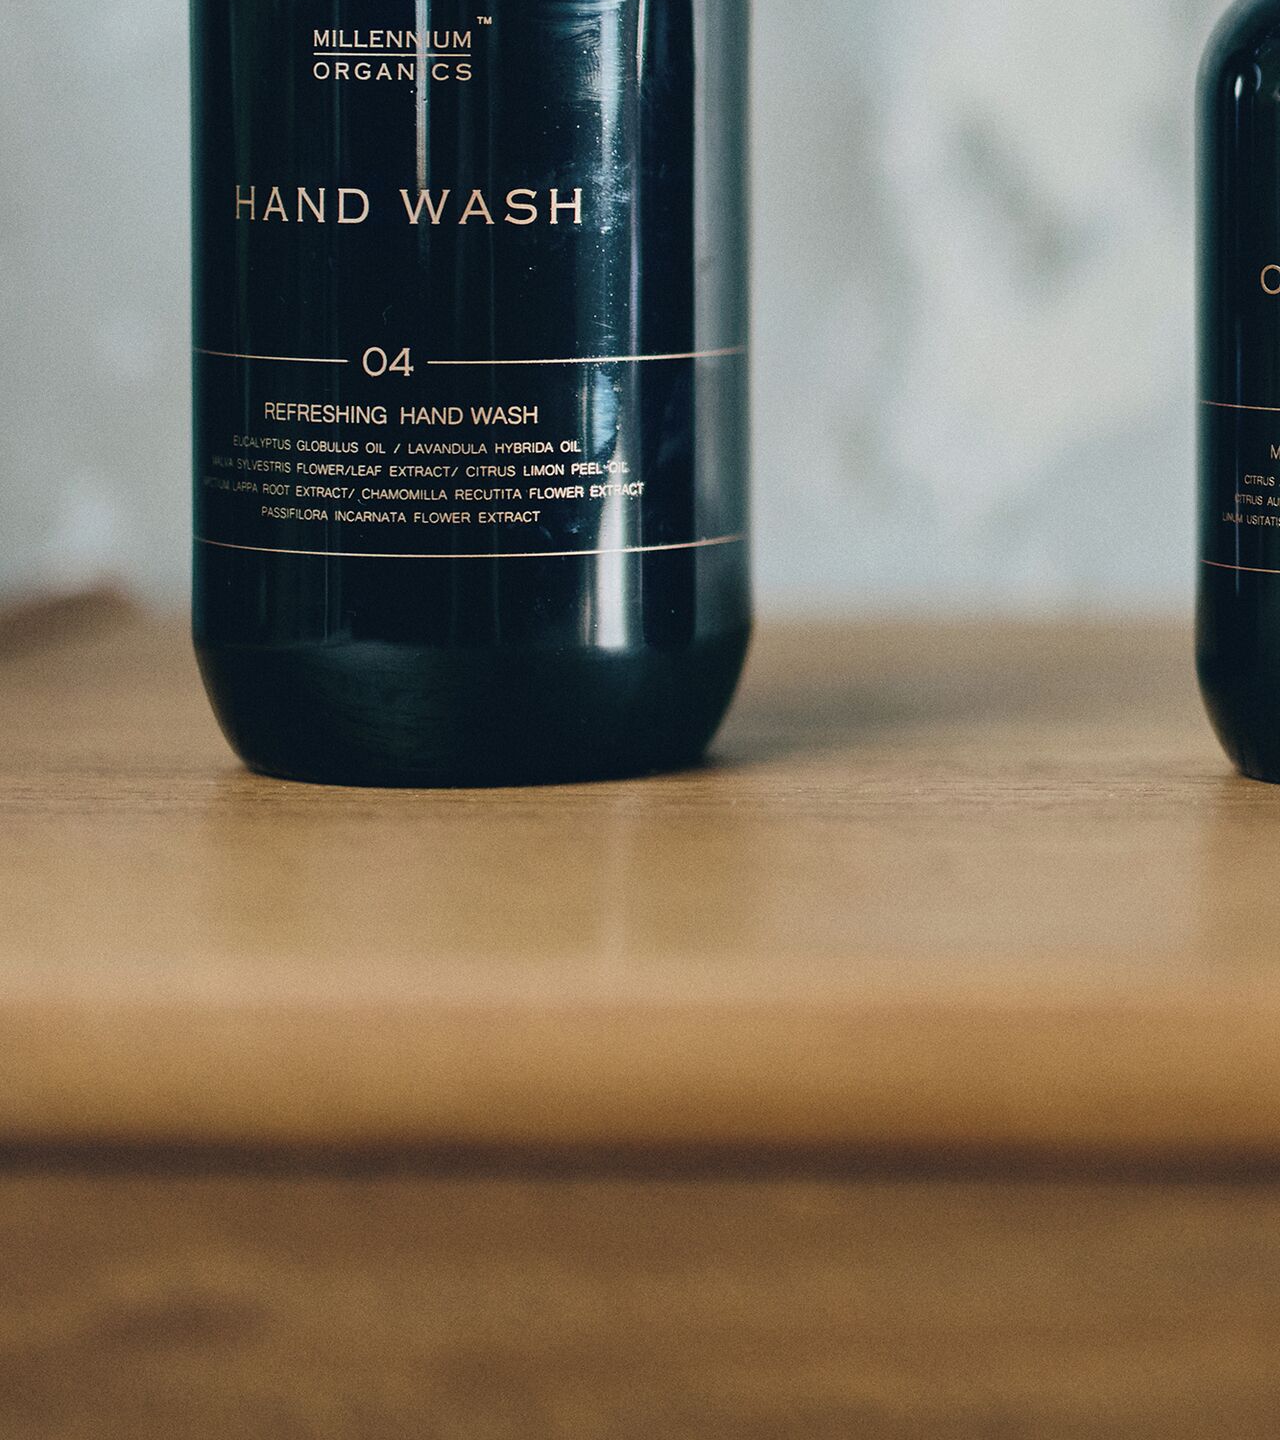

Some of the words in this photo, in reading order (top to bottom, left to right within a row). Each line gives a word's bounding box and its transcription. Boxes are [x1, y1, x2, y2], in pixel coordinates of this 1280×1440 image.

[313, 29, 472, 49] MILLENNIUM
[313, 62, 472, 81] ORGANCS
[235, 185, 370, 224] HAND
[399, 187, 584, 225] WASH
[362, 347, 414, 377] 04
[264, 402, 388, 425] REFRESHING
[400, 406, 463, 426] HAND
[469, 406, 539, 425] WASH
[233, 435, 292, 452] EUCALYPTUS
[296, 440, 359, 453] GLOBULUS
[365, 442, 386, 454] OIL
[408, 443, 488, 455] LAVANDULA
[495, 441, 554, 454] HYBRIDA
[560, 440, 582, 453] OIL
[236, 458, 292, 474] SYLVESTRIS
[296, 462, 382, 477] FLOWER/LEAF
[466, 465, 516, 477] CITRUS
[523, 463, 565, 477] LIMON
[571, 461, 603, 475] PEEL
[1244, 474, 1275, 486] CITRUS
[232, 480, 259, 493] LAPPA
[262, 483, 290, 496] ROOT
[361, 488, 448, 501] CHAMOMILLA
[455, 488, 522, 501] RECUTITA
[529, 486, 584, 499] FLOWER
[589, 481, 645, 498] EXTRACT
[1235, 493, 1263, 506] CITRUS
[261, 506, 328, 521] PASSIFILORA
[334, 510, 407, 524] INCARNATA
[414, 511, 470, 524] FLOWER
[478, 511, 541, 524] EXTRACT
